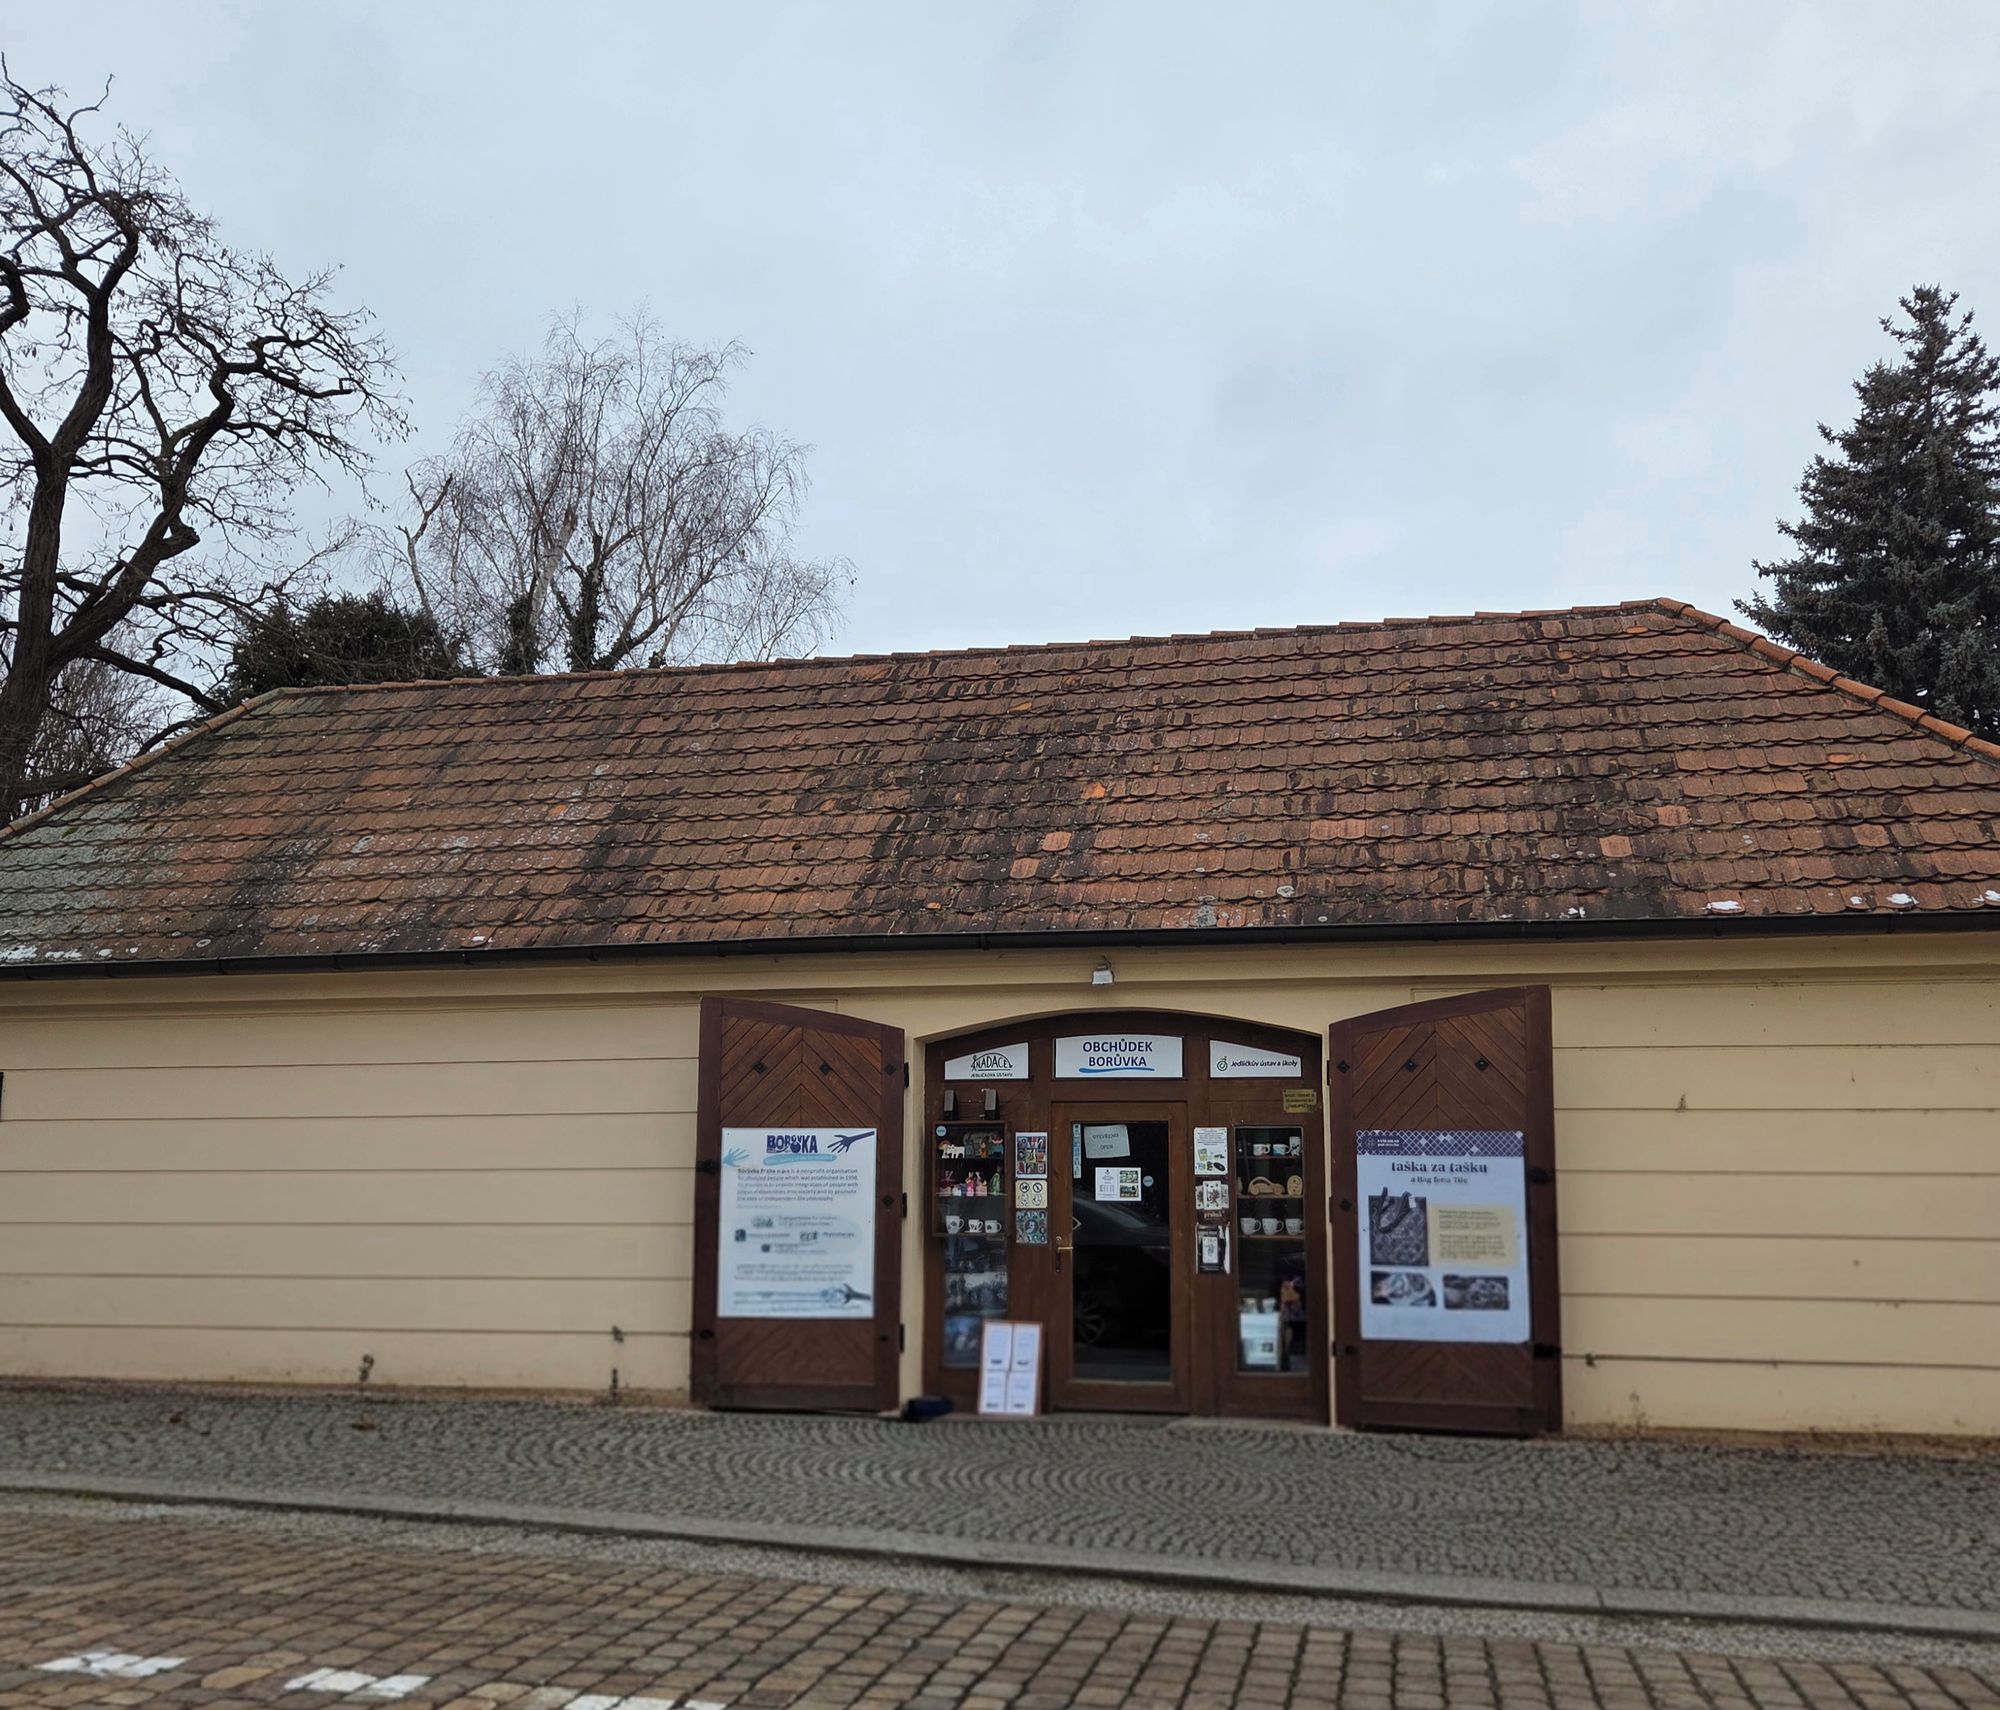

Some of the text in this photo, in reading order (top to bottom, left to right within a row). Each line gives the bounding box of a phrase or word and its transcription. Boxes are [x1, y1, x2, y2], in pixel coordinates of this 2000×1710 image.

[1082, 1038, 1153, 1053] OBCHŮDEK
[976, 1055, 1008, 1069] NADACE
[1088, 1053, 1147, 1067] BORŮVKA
[1259, 1060, 1276, 1068] ústav
[1282, 1060, 1298, 1069] školy
[1391, 1161, 1488, 1174] taška za tašku
